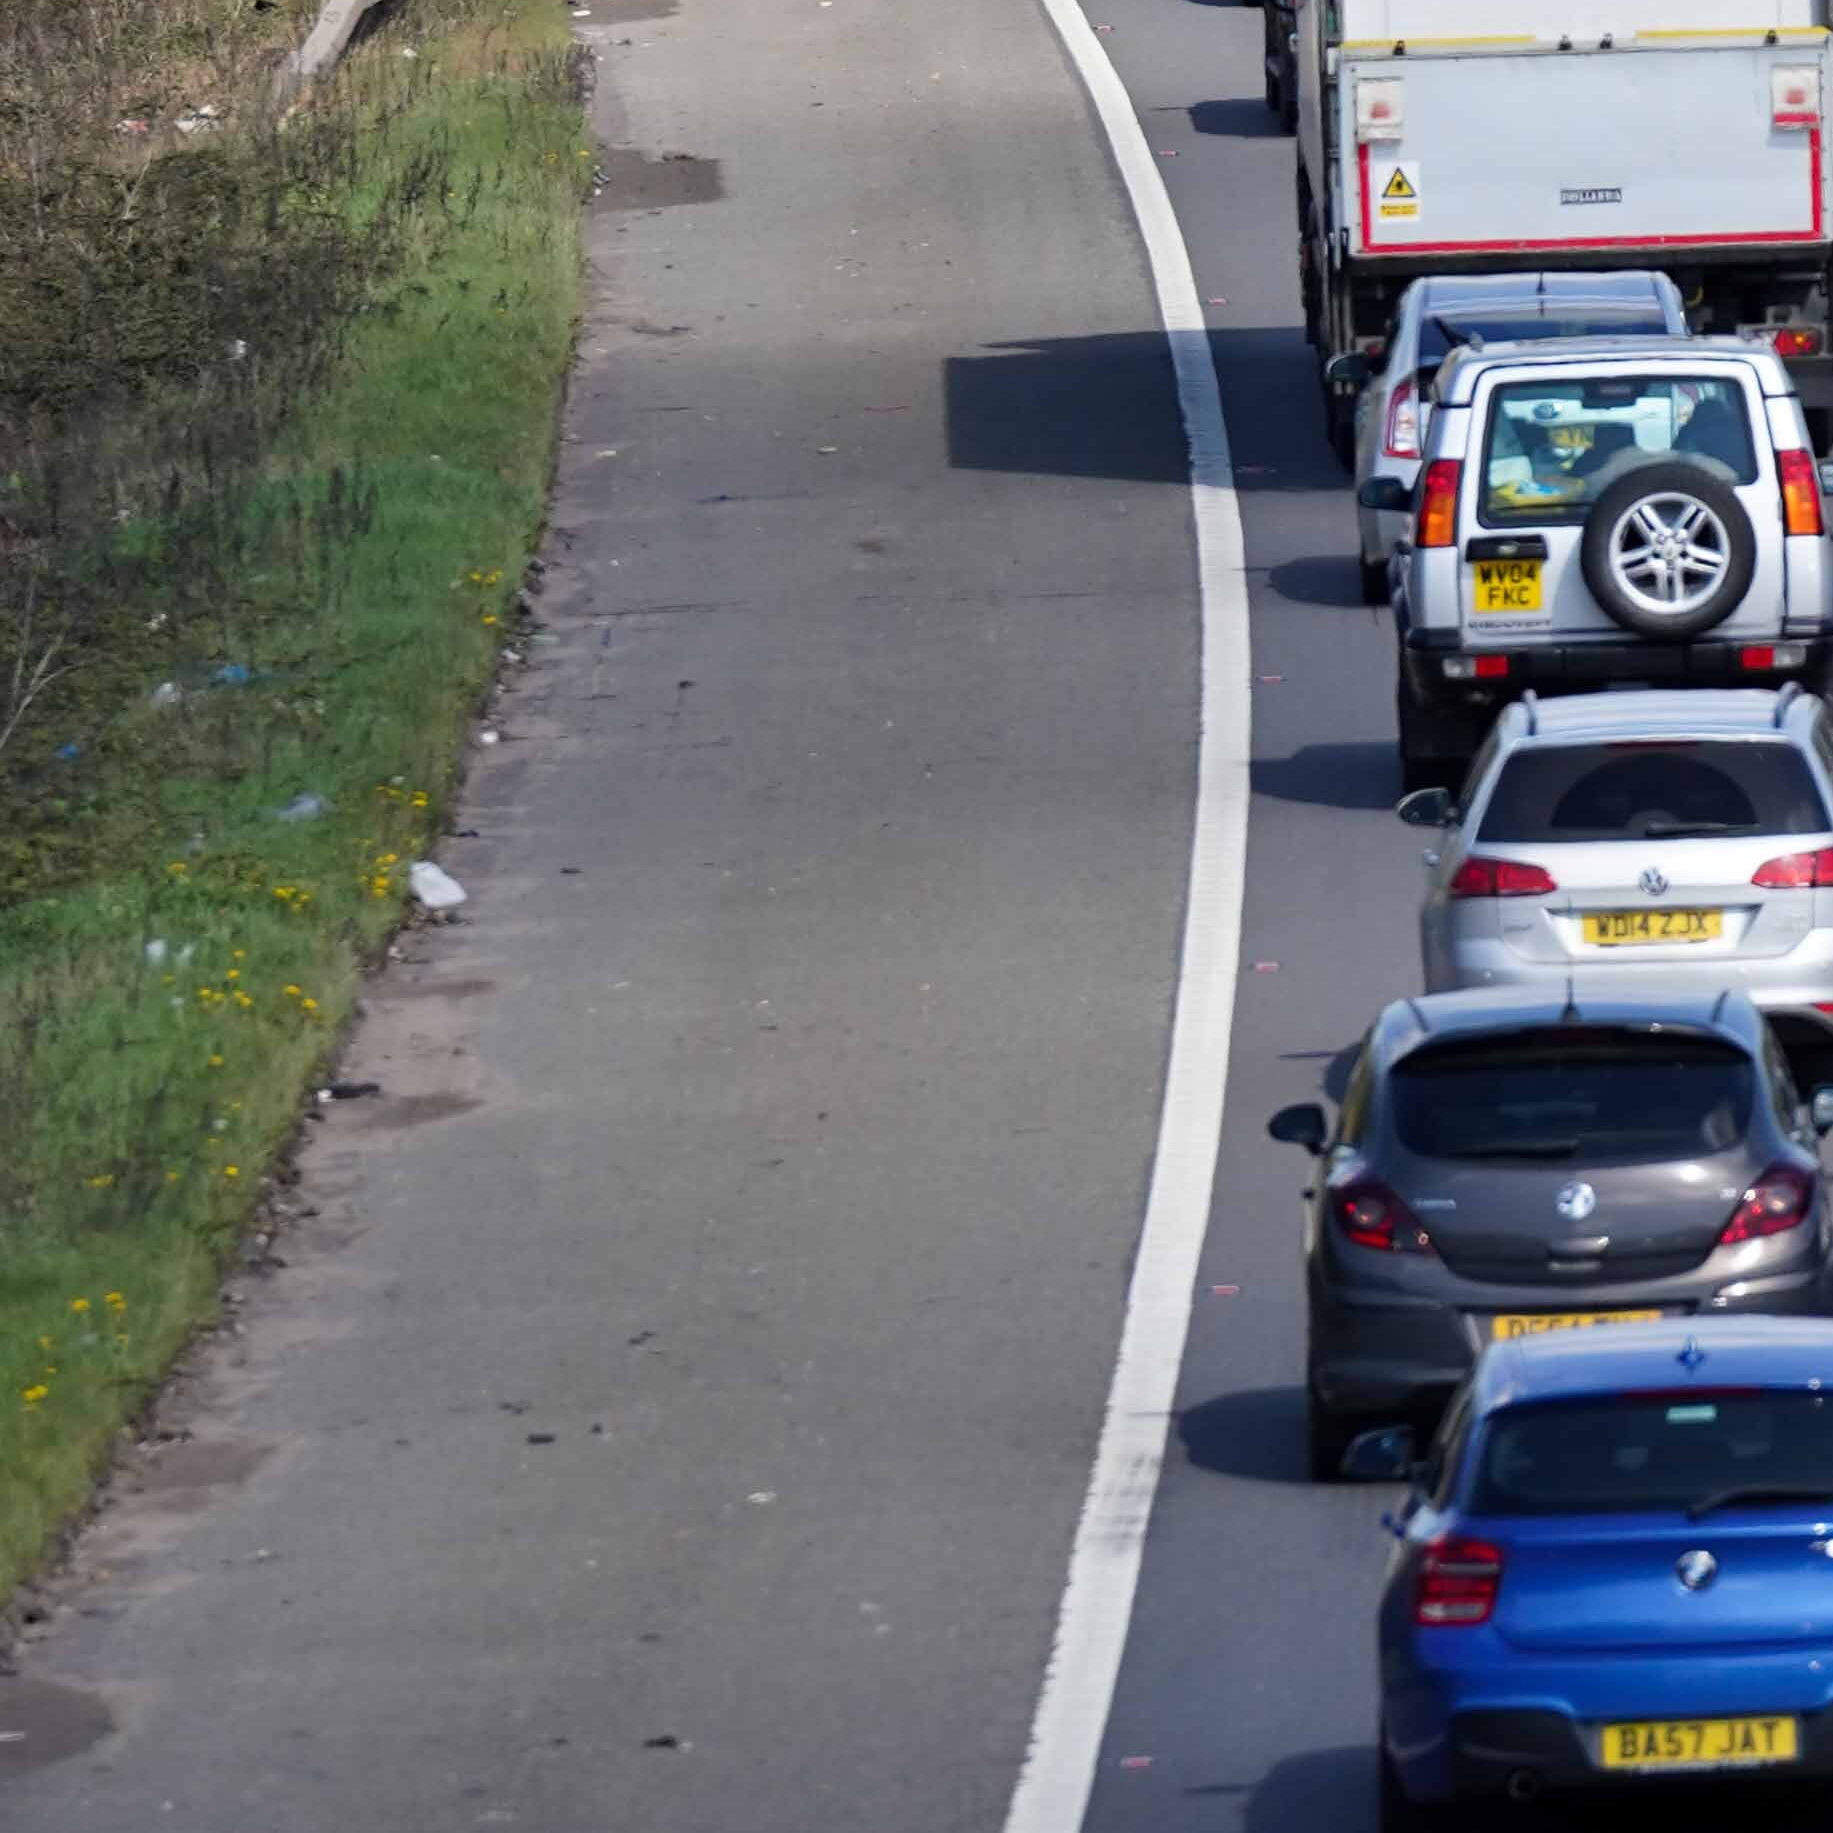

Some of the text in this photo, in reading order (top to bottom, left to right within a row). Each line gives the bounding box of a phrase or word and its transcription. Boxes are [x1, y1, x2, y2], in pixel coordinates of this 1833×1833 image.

[1480, 568, 1536, 586] WV04
[1488, 587, 1529, 606] FKC
[1660, 912, 1708, 935] ZJX
[1619, 1722, 1781, 1759] BA57 JAT
